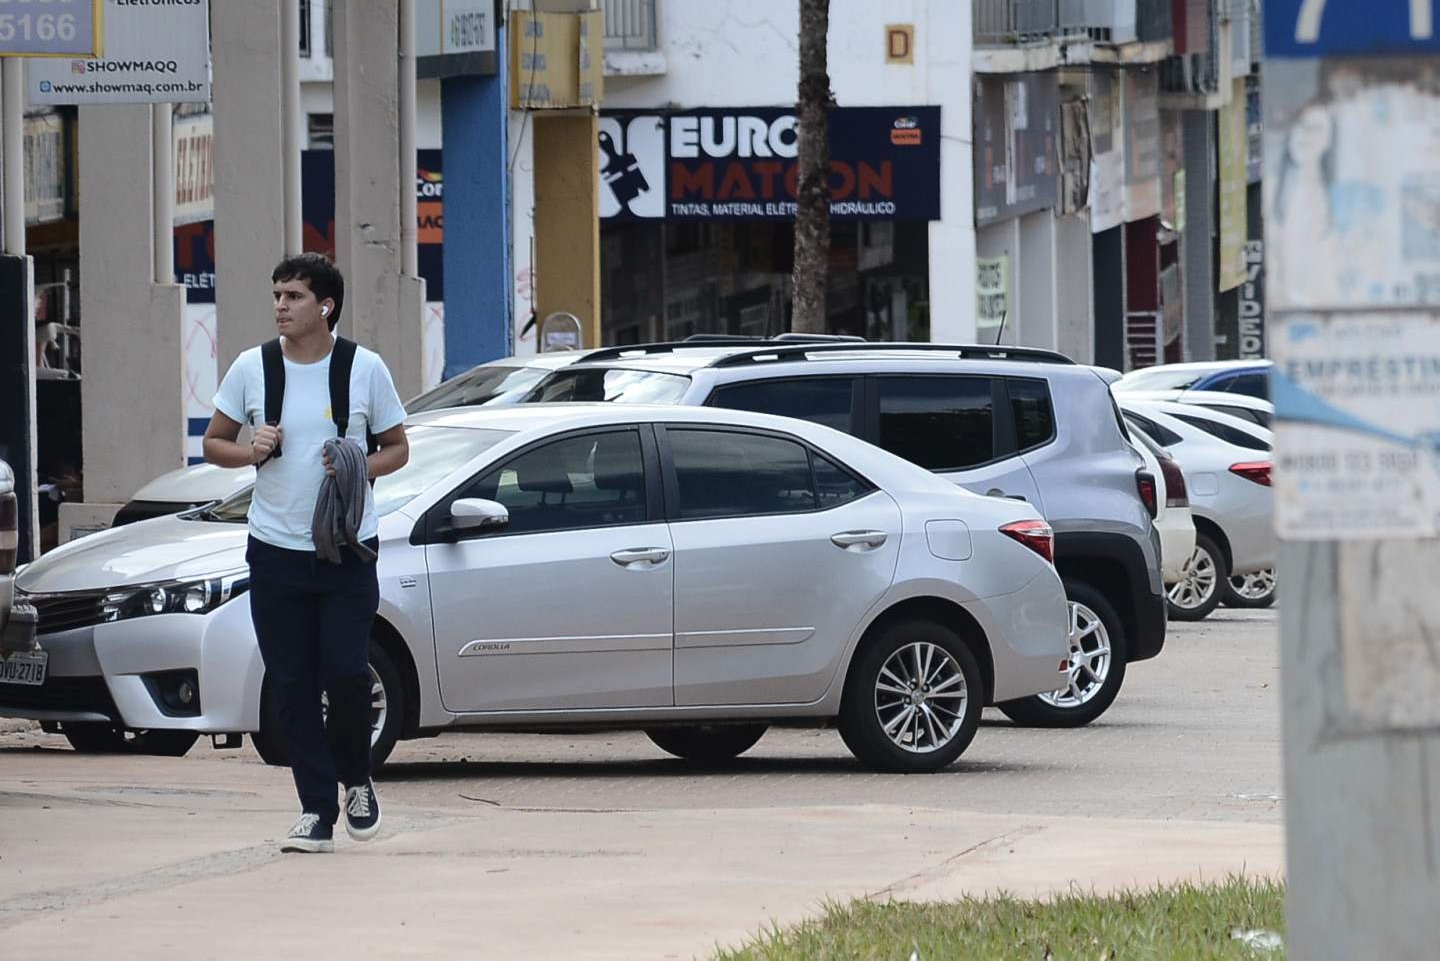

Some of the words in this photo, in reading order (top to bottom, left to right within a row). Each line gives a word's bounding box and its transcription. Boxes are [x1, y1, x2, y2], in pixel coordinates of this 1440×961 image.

[888, 30, 909, 58] D
[87, 59, 178, 75] SHOWMAQQ
[53, 79, 204, 95] www.showmaq.com.br
[670, 115, 800, 158] EURO
[672, 203, 711, 216] TINTAS,
[713, 203, 764, 216] MATERIAL
[830, 200, 896, 215] HIDRÁULICO
[472, 643, 510, 651] COROLLA
